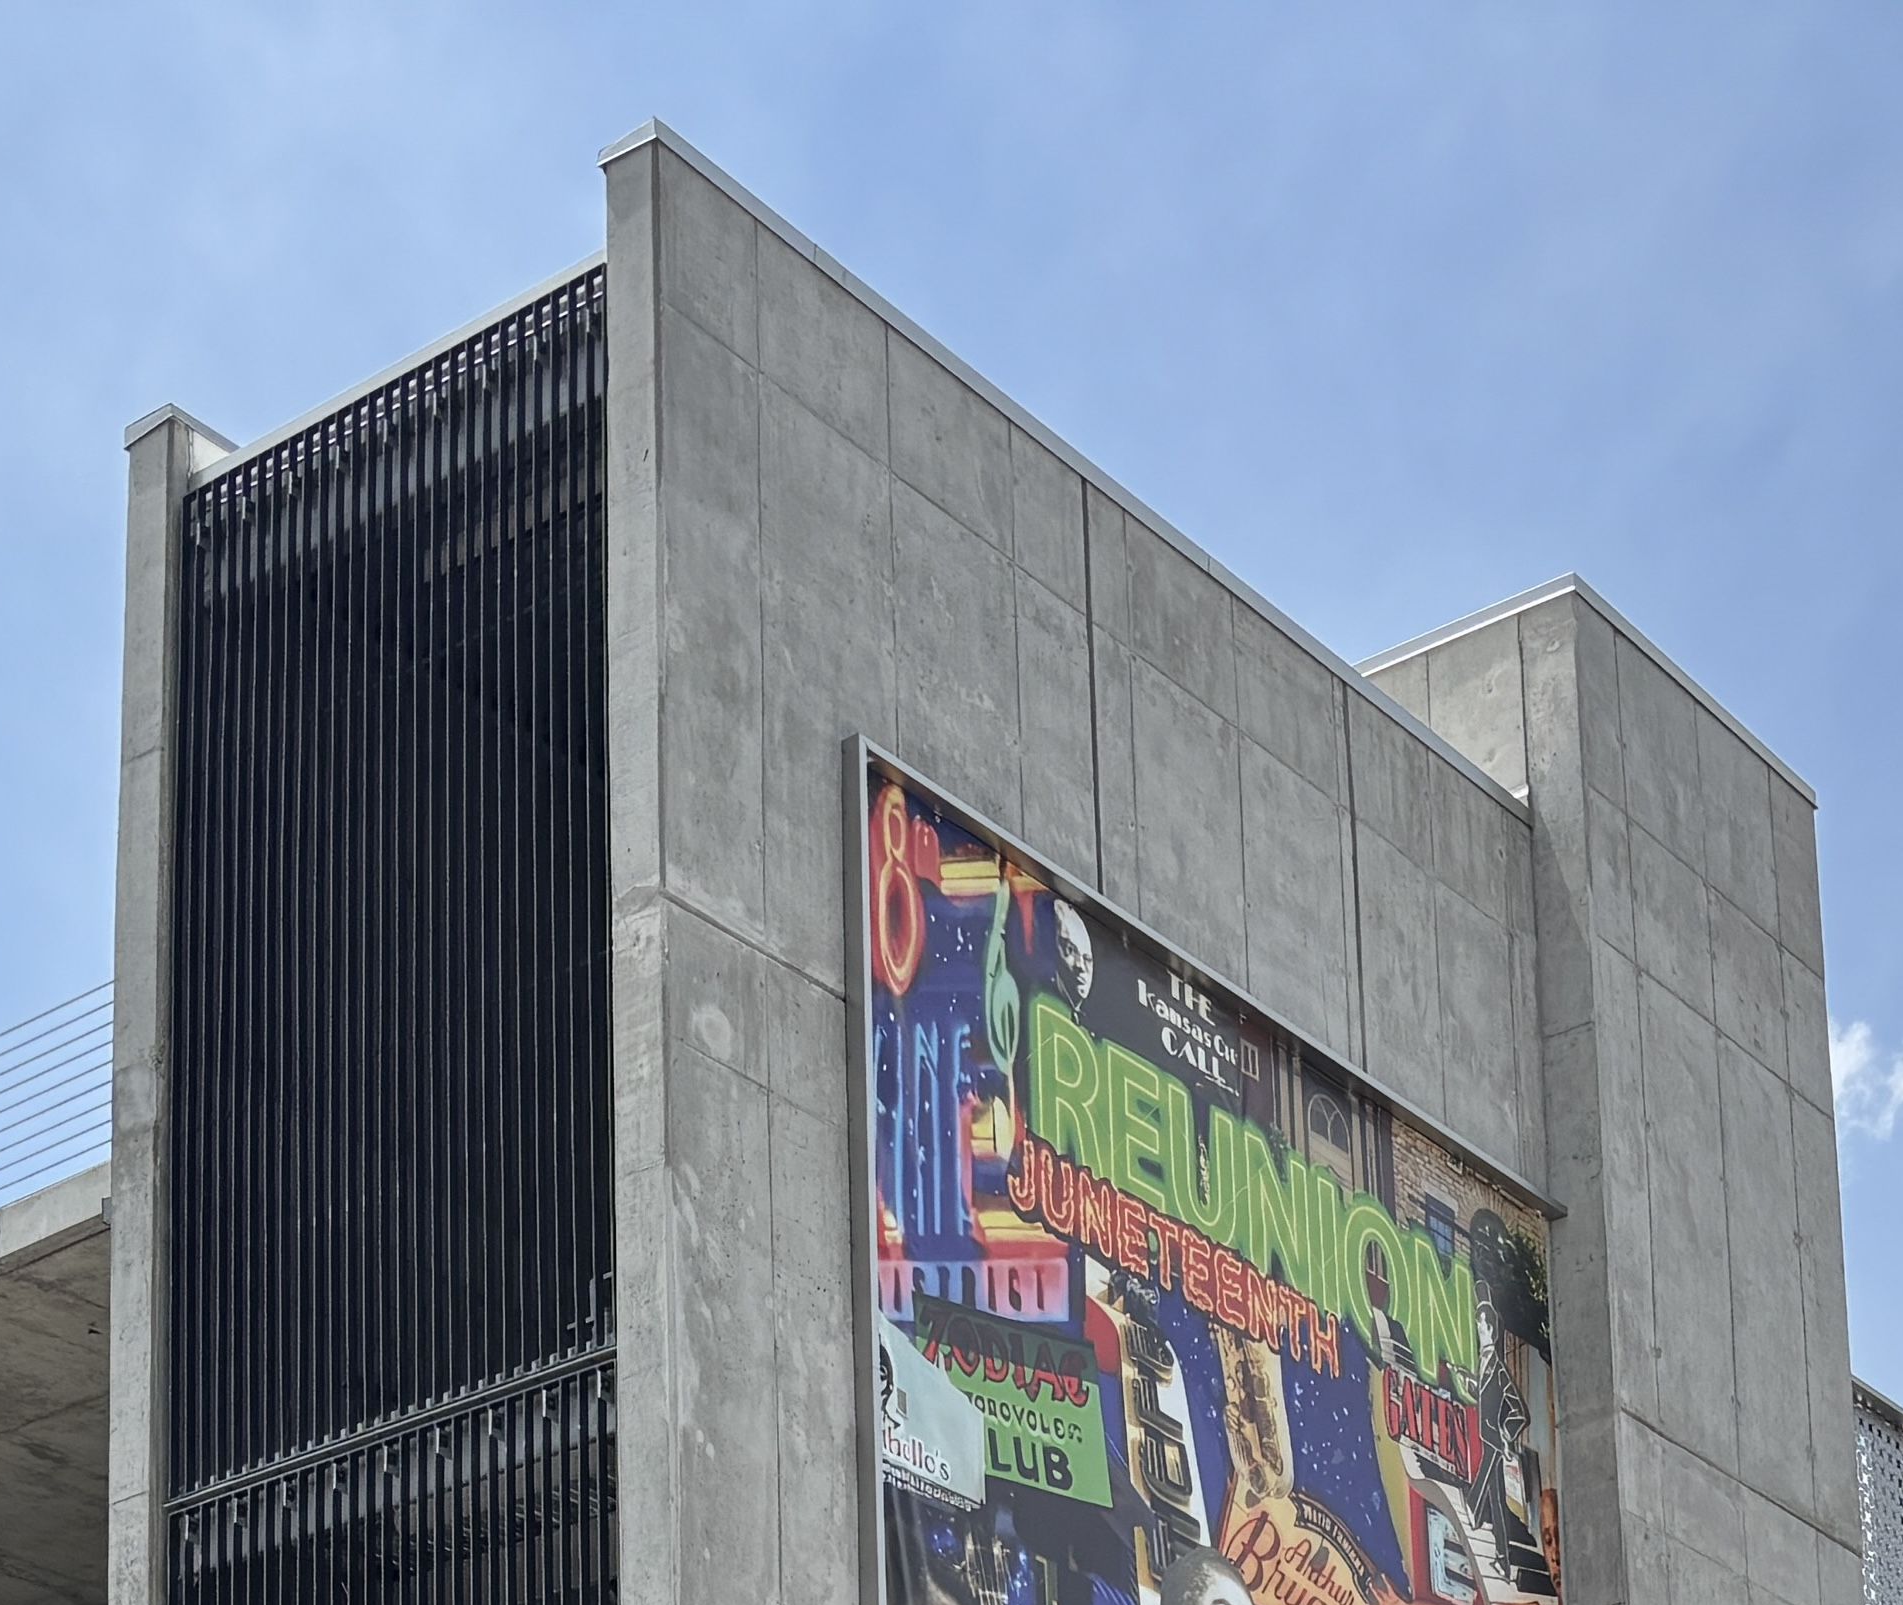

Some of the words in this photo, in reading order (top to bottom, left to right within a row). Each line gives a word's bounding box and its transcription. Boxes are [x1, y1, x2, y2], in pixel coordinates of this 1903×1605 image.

[1137, 978, 1212, 1049] Kansas
[1213, 1033, 1239, 1066] Cit
[1166, 967, 1216, 1027] THE
[1161, 1026, 1228, 1082] CALL
[1028, 995, 1484, 1404] REUNION
[1006, 1137, 1341, 1380] JUNETEENTH
[920, 1303, 1090, 1408] ZODIAC
[1383, 1364, 1470, 1484] GATES
